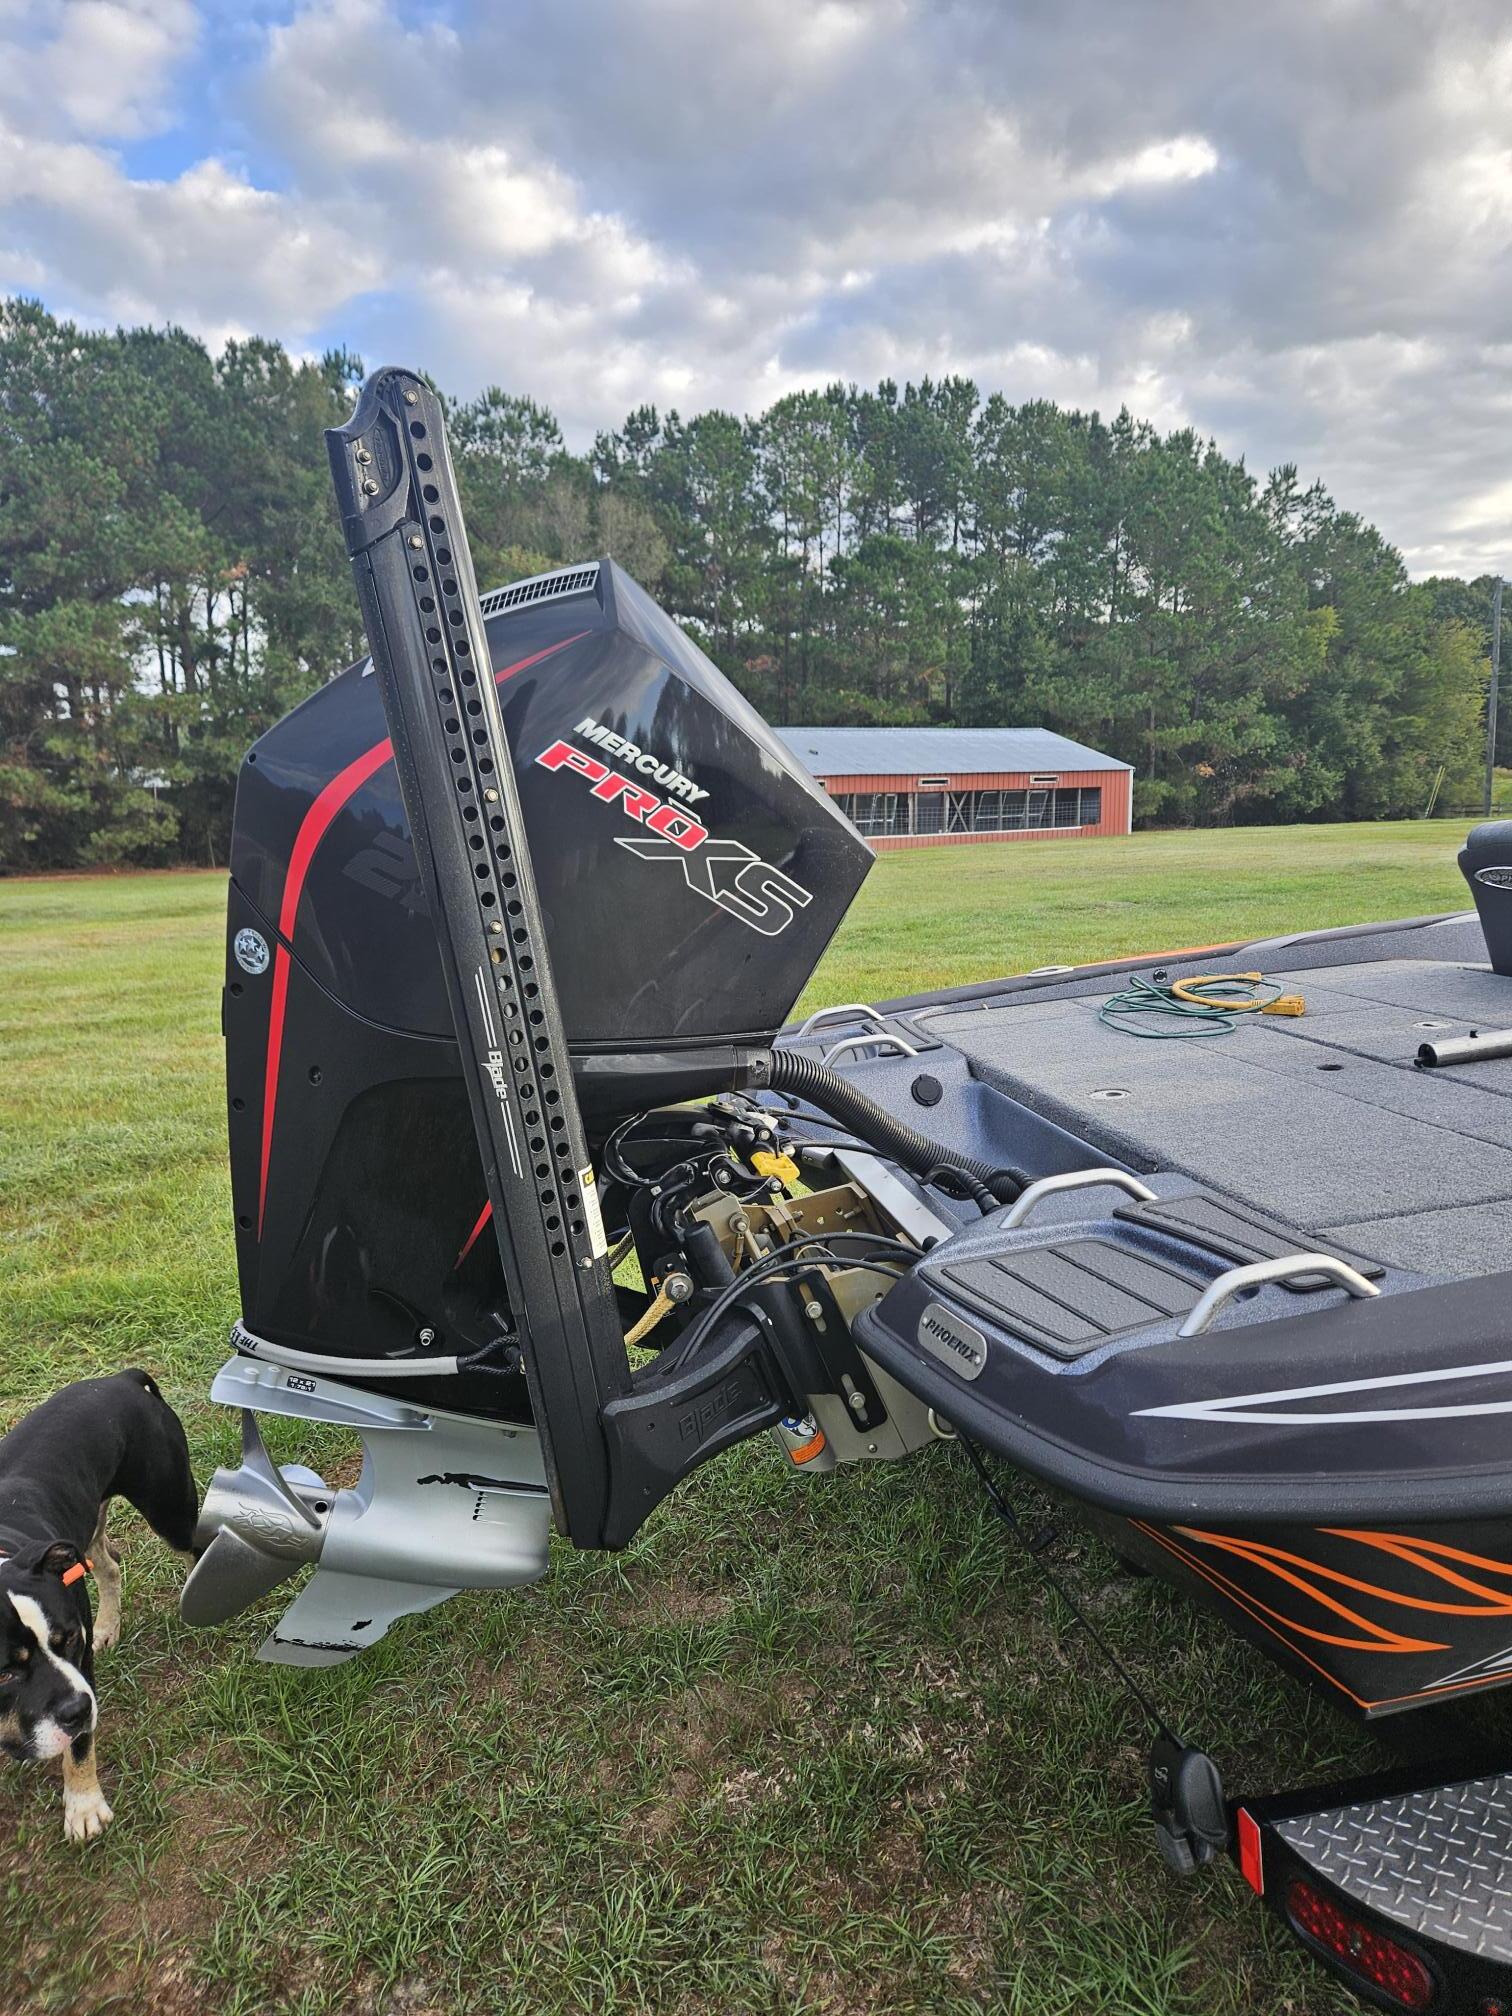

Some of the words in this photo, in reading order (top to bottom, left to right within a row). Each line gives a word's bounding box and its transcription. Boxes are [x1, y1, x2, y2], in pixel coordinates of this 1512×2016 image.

[534, 739, 709, 851] PRO
[573, 717, 710, 804] MERCURY
[613, 797, 813, 936] XS
[480, 1050, 508, 1100] Blade
[925, 1318, 979, 1362] PHOENIX
